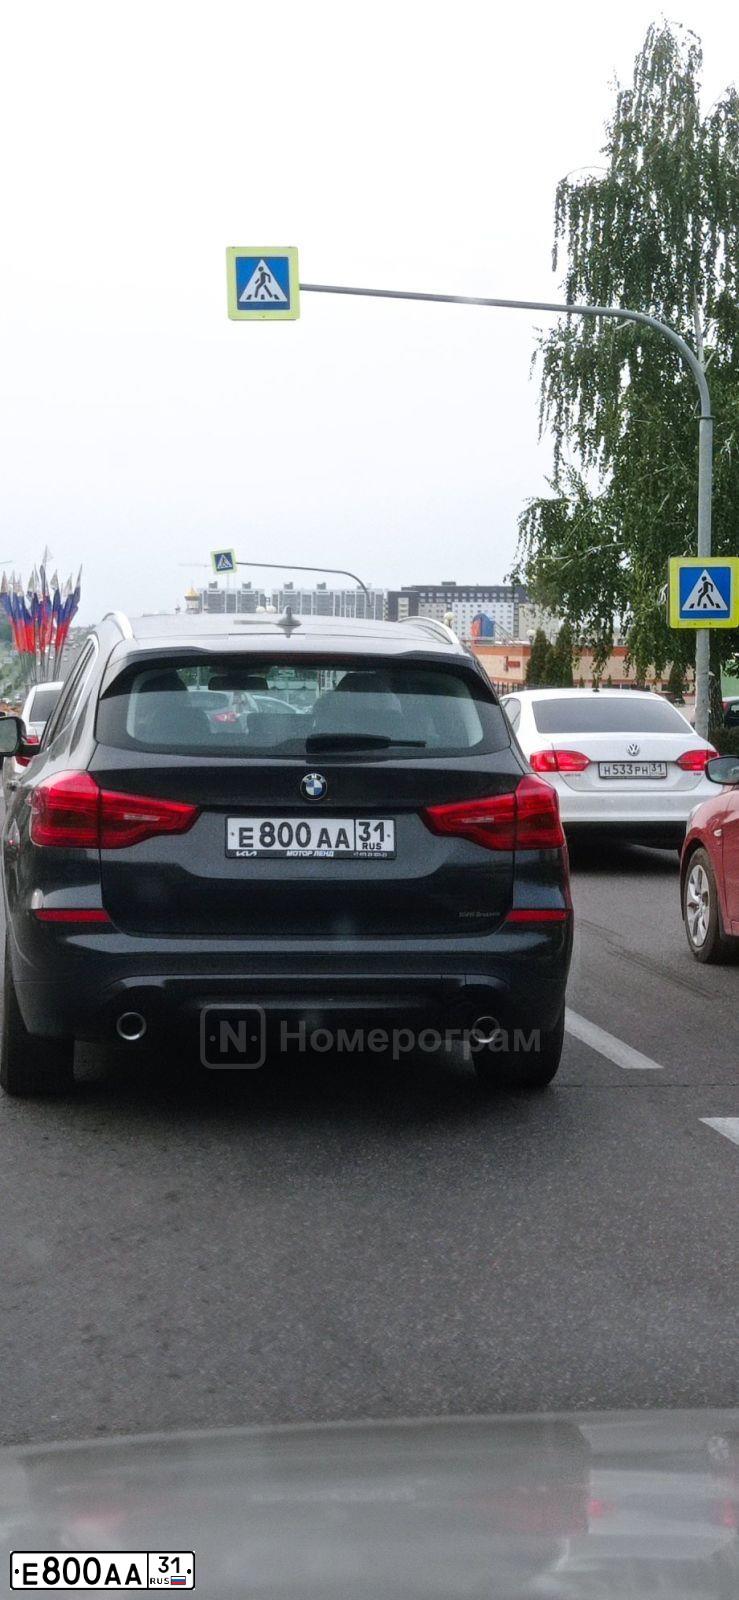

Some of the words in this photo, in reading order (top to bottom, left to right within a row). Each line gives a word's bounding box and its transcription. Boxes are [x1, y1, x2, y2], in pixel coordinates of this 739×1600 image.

[239, 822, 350, 848] Е800АА
[358, 821, 385, 842] 31
[362, 842, 382, 850] RUS
